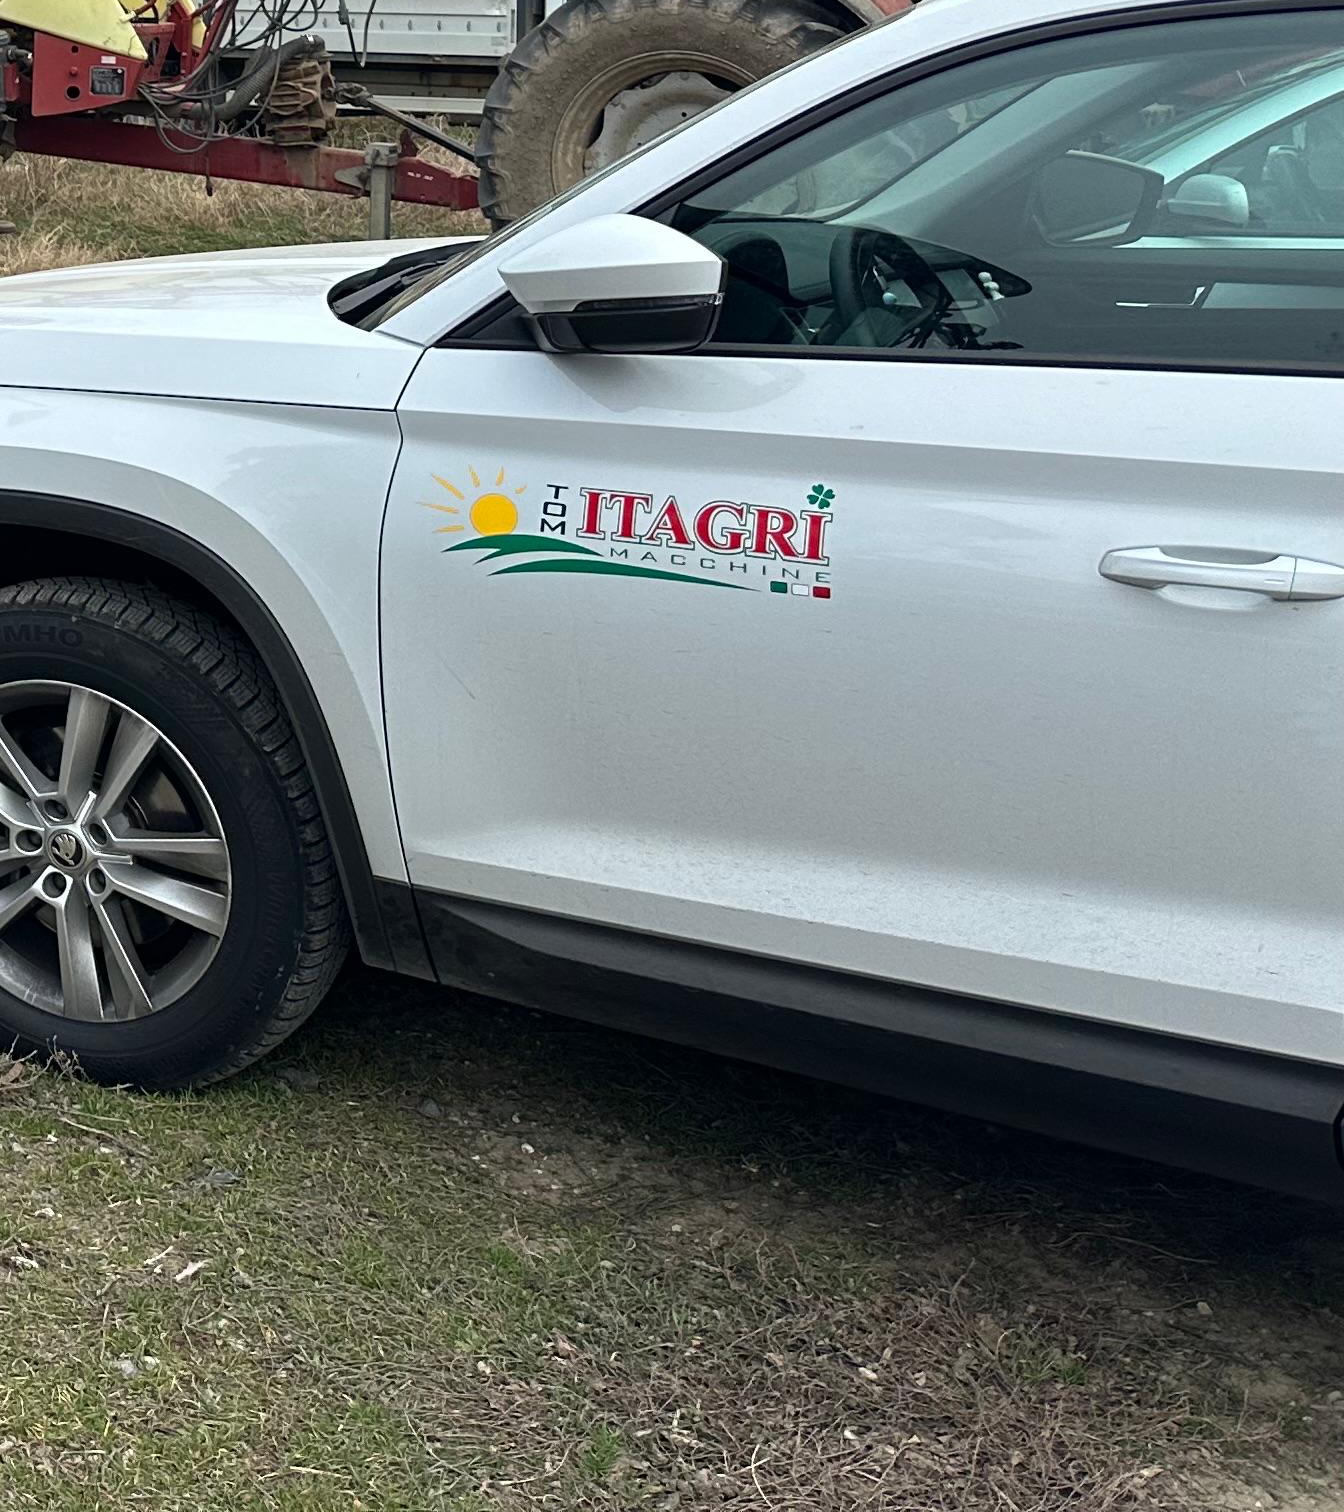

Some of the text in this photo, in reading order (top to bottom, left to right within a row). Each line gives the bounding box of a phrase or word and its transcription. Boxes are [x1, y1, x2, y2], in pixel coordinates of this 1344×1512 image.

[540, 484, 569, 536] TOM
[577, 486, 832, 567] ITAGRI
[609, 548, 832, 584] MACCHINE
